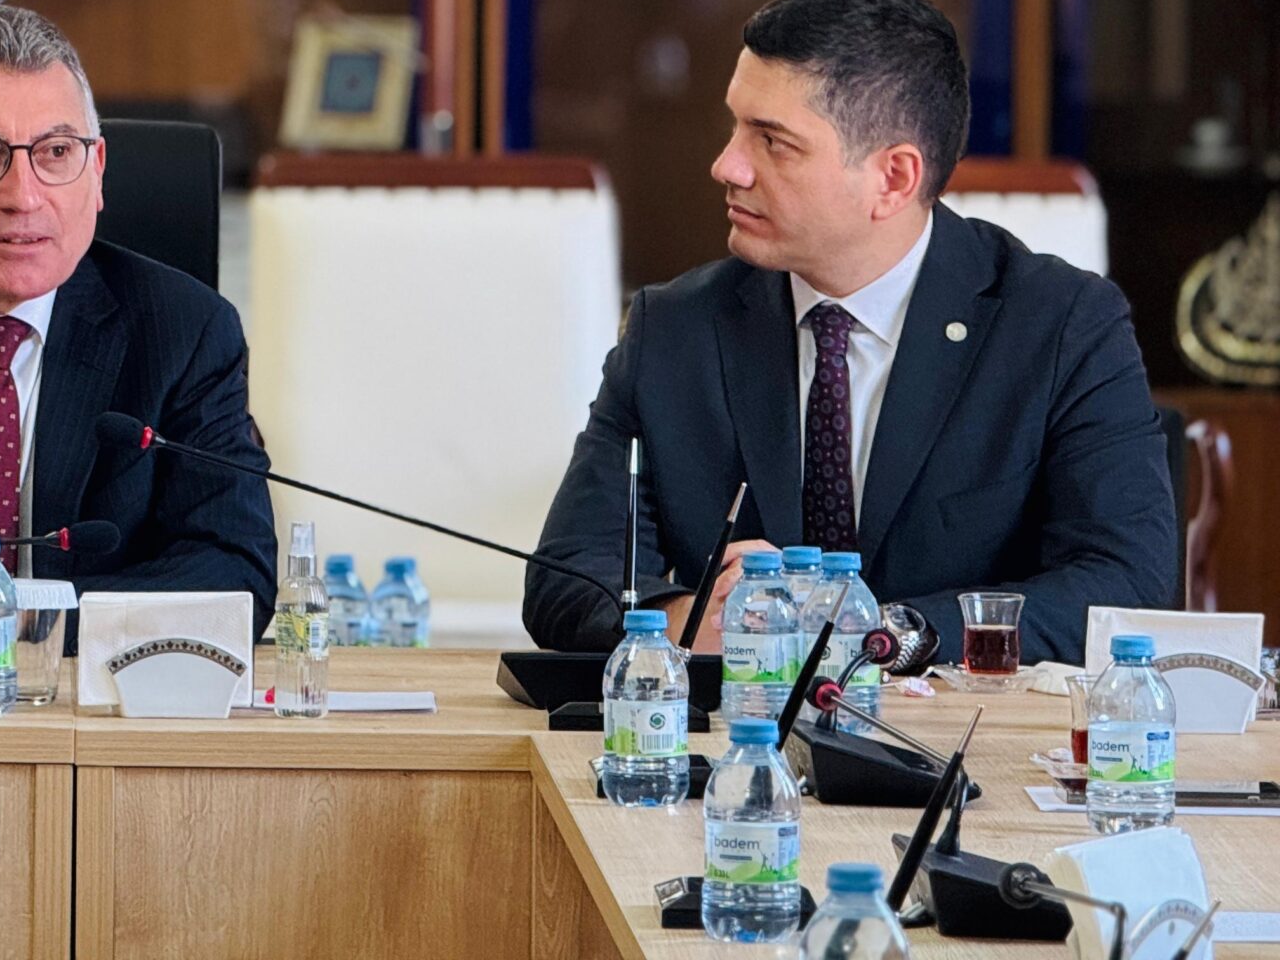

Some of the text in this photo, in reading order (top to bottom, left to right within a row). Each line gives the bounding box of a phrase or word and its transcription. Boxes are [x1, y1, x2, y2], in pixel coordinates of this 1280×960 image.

[724, 645, 756, 656] badem
[1091, 740, 1130, 753] badem
[714, 836, 760, 850] badem
